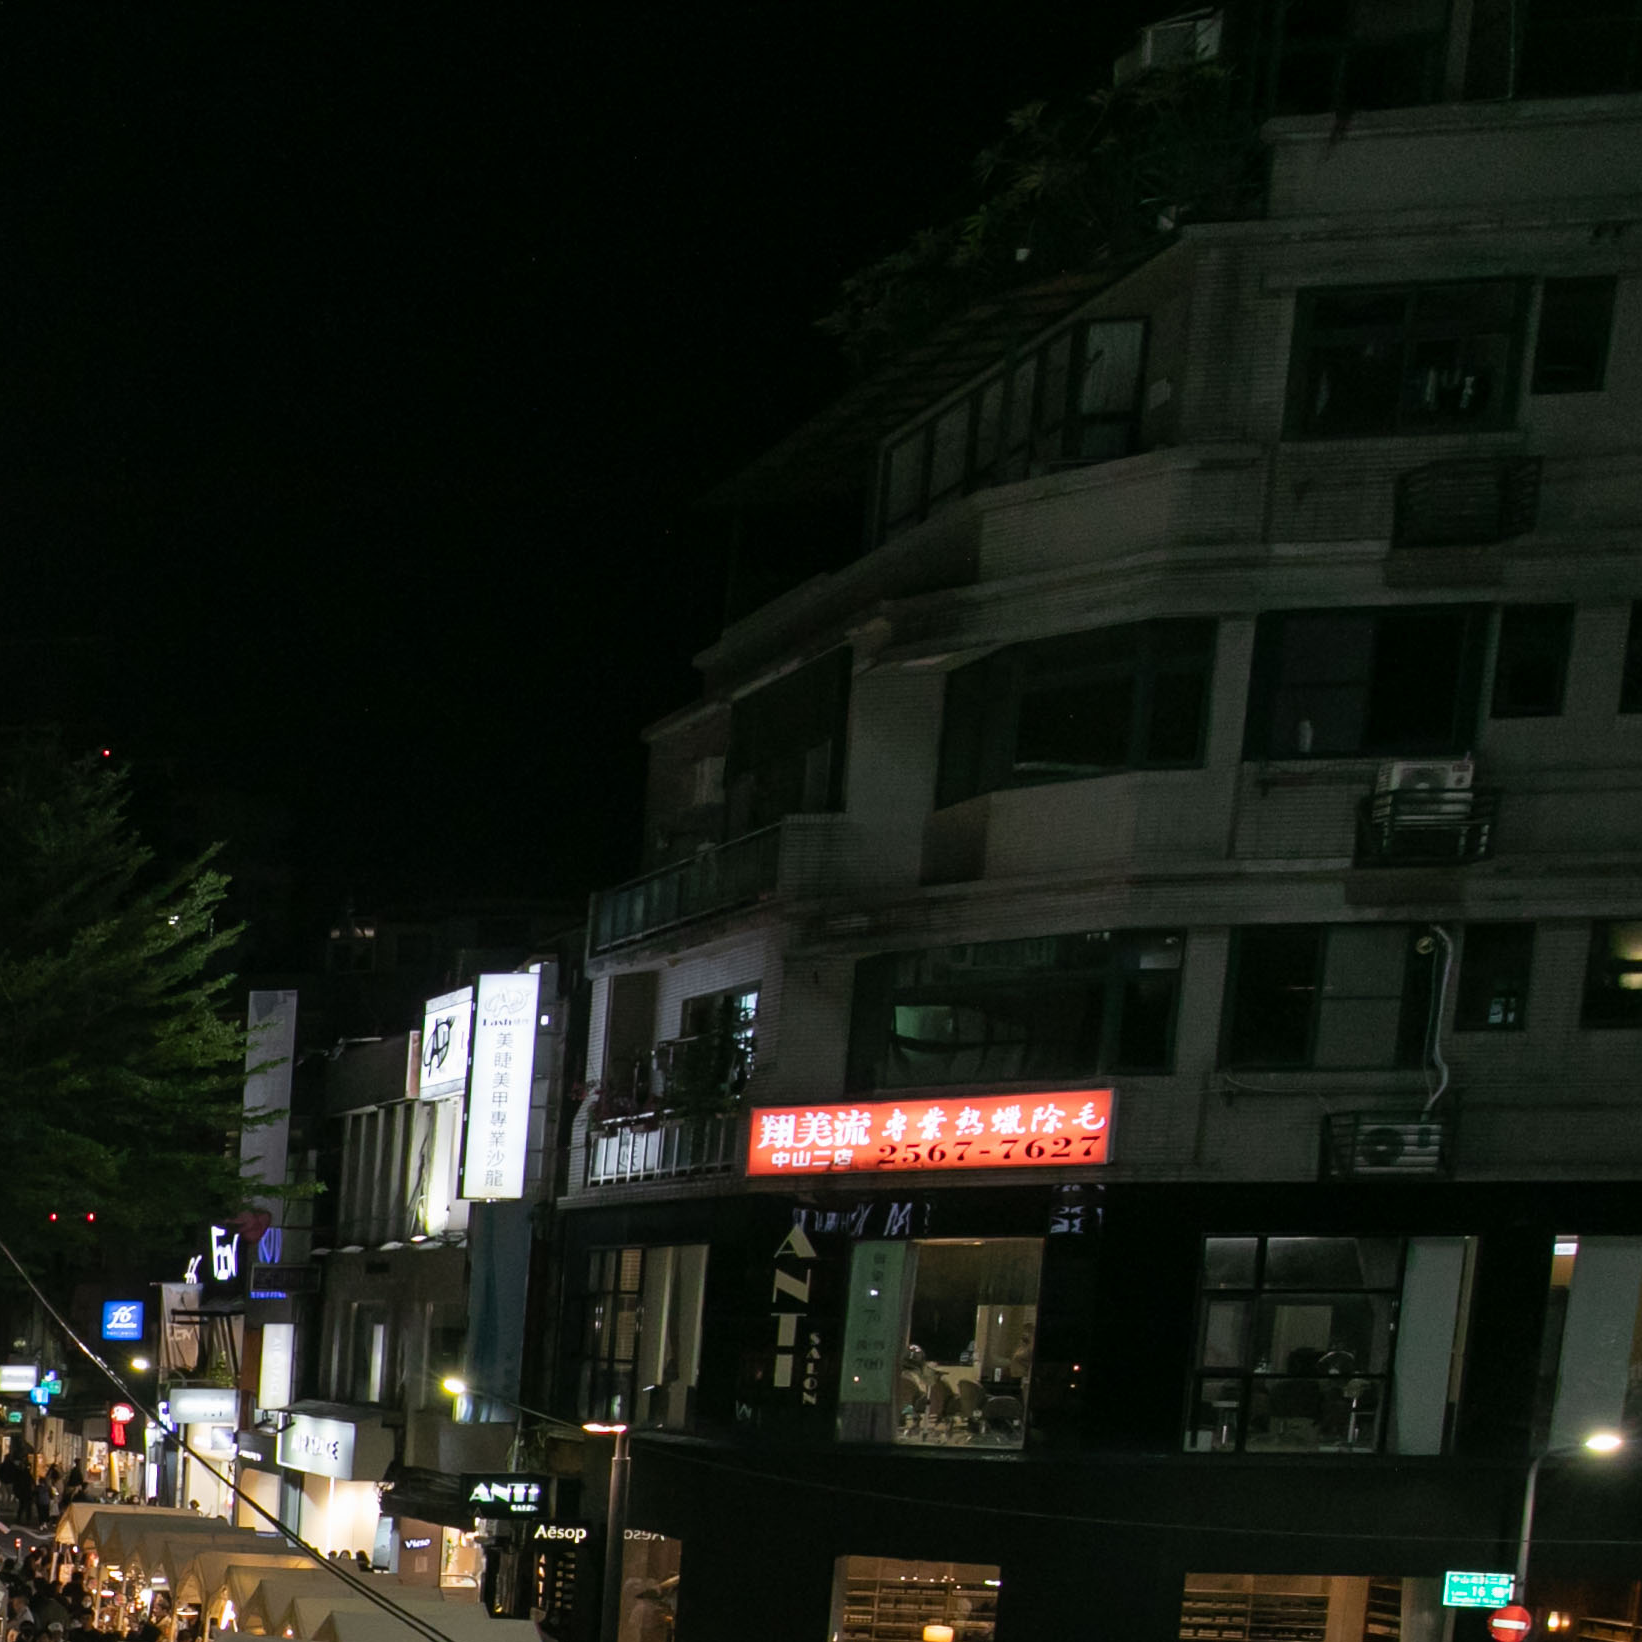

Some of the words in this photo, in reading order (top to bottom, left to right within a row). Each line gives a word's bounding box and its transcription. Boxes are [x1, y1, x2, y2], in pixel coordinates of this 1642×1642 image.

[757, 1109, 873, 1149] 翔美流
[881, 1101, 1107, 1142] 專業熱蠟除毛
[772, 1149, 854, 1168] 中山二店
[877, 1135, 1101, 1165] 2567-7627
[770, 1223, 818, 1387] ANTI
[802, 1332, 822, 1406] SALON
[469, 1482, 540, 1502] ANTI
[534, 1525, 587, 1544] Aēsop
